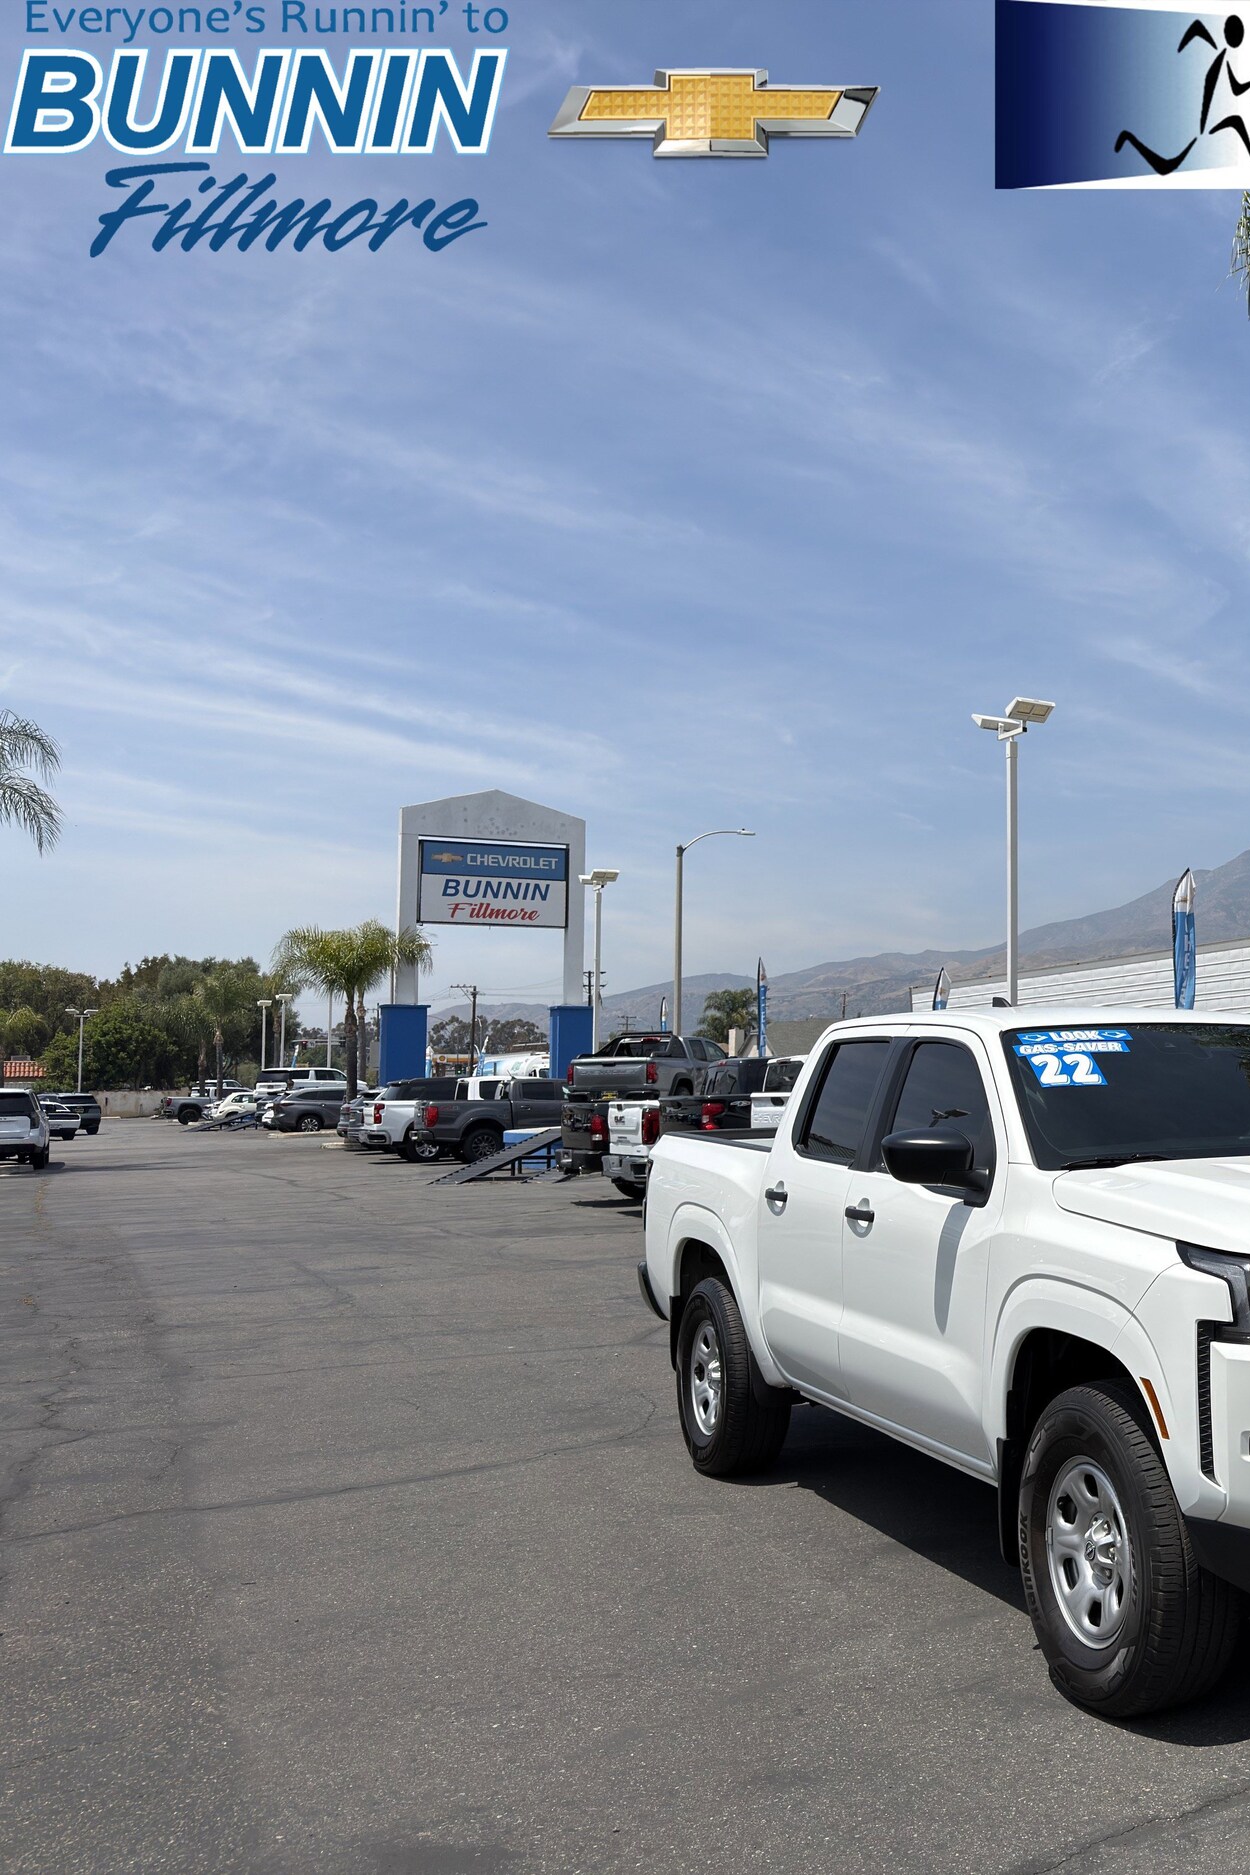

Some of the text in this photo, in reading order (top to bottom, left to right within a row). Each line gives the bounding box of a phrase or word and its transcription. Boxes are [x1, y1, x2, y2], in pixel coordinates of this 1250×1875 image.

[466, 853, 558, 869] CHEVROLET
[442, 878, 550, 901] BUNNIN
[447, 902, 540, 921] Fillmore
[1049, 1030, 1104, 1042] LOOK
[1019, 1041, 1124, 1055] GAS-SAVER
[1030, 1053, 1102, 1085] 22
